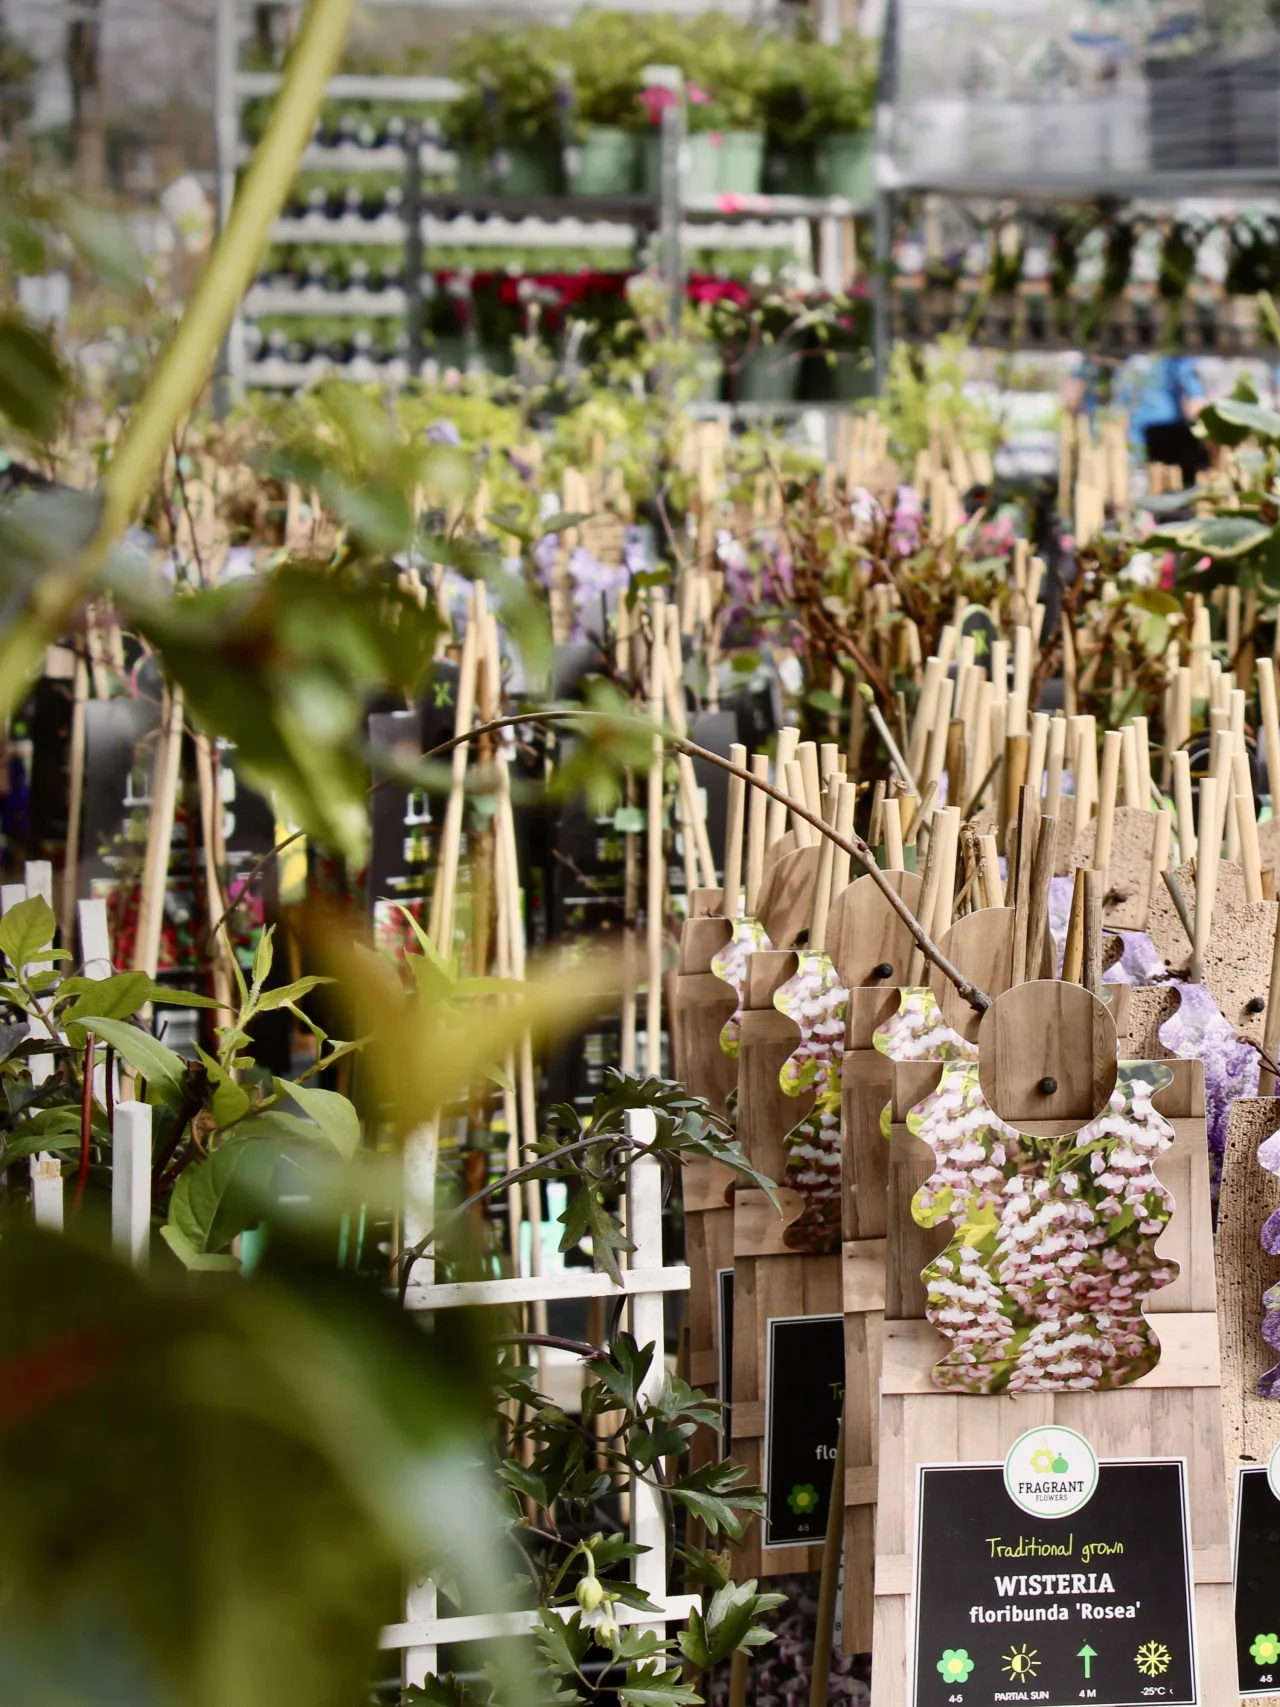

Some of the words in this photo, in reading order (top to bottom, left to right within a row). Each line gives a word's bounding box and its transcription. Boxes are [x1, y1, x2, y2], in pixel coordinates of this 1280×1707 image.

[1018, 1480, 1085, 1494] FRAGRANT
[1035, 1494, 1068, 1502] FLOWERS
[985, 1533, 1073, 1559] Traditional
[1082, 1542, 1124, 1563] grown
[994, 1572, 1116, 1597] WISTERIA
[969, 1603, 1069, 1624] floribunda
[1076, 1601, 1141, 1620] 'Rosea'
[994, 1691, 1027, 1701] PARTIAL
[1028, 1690, 1049, 1699] SUN
